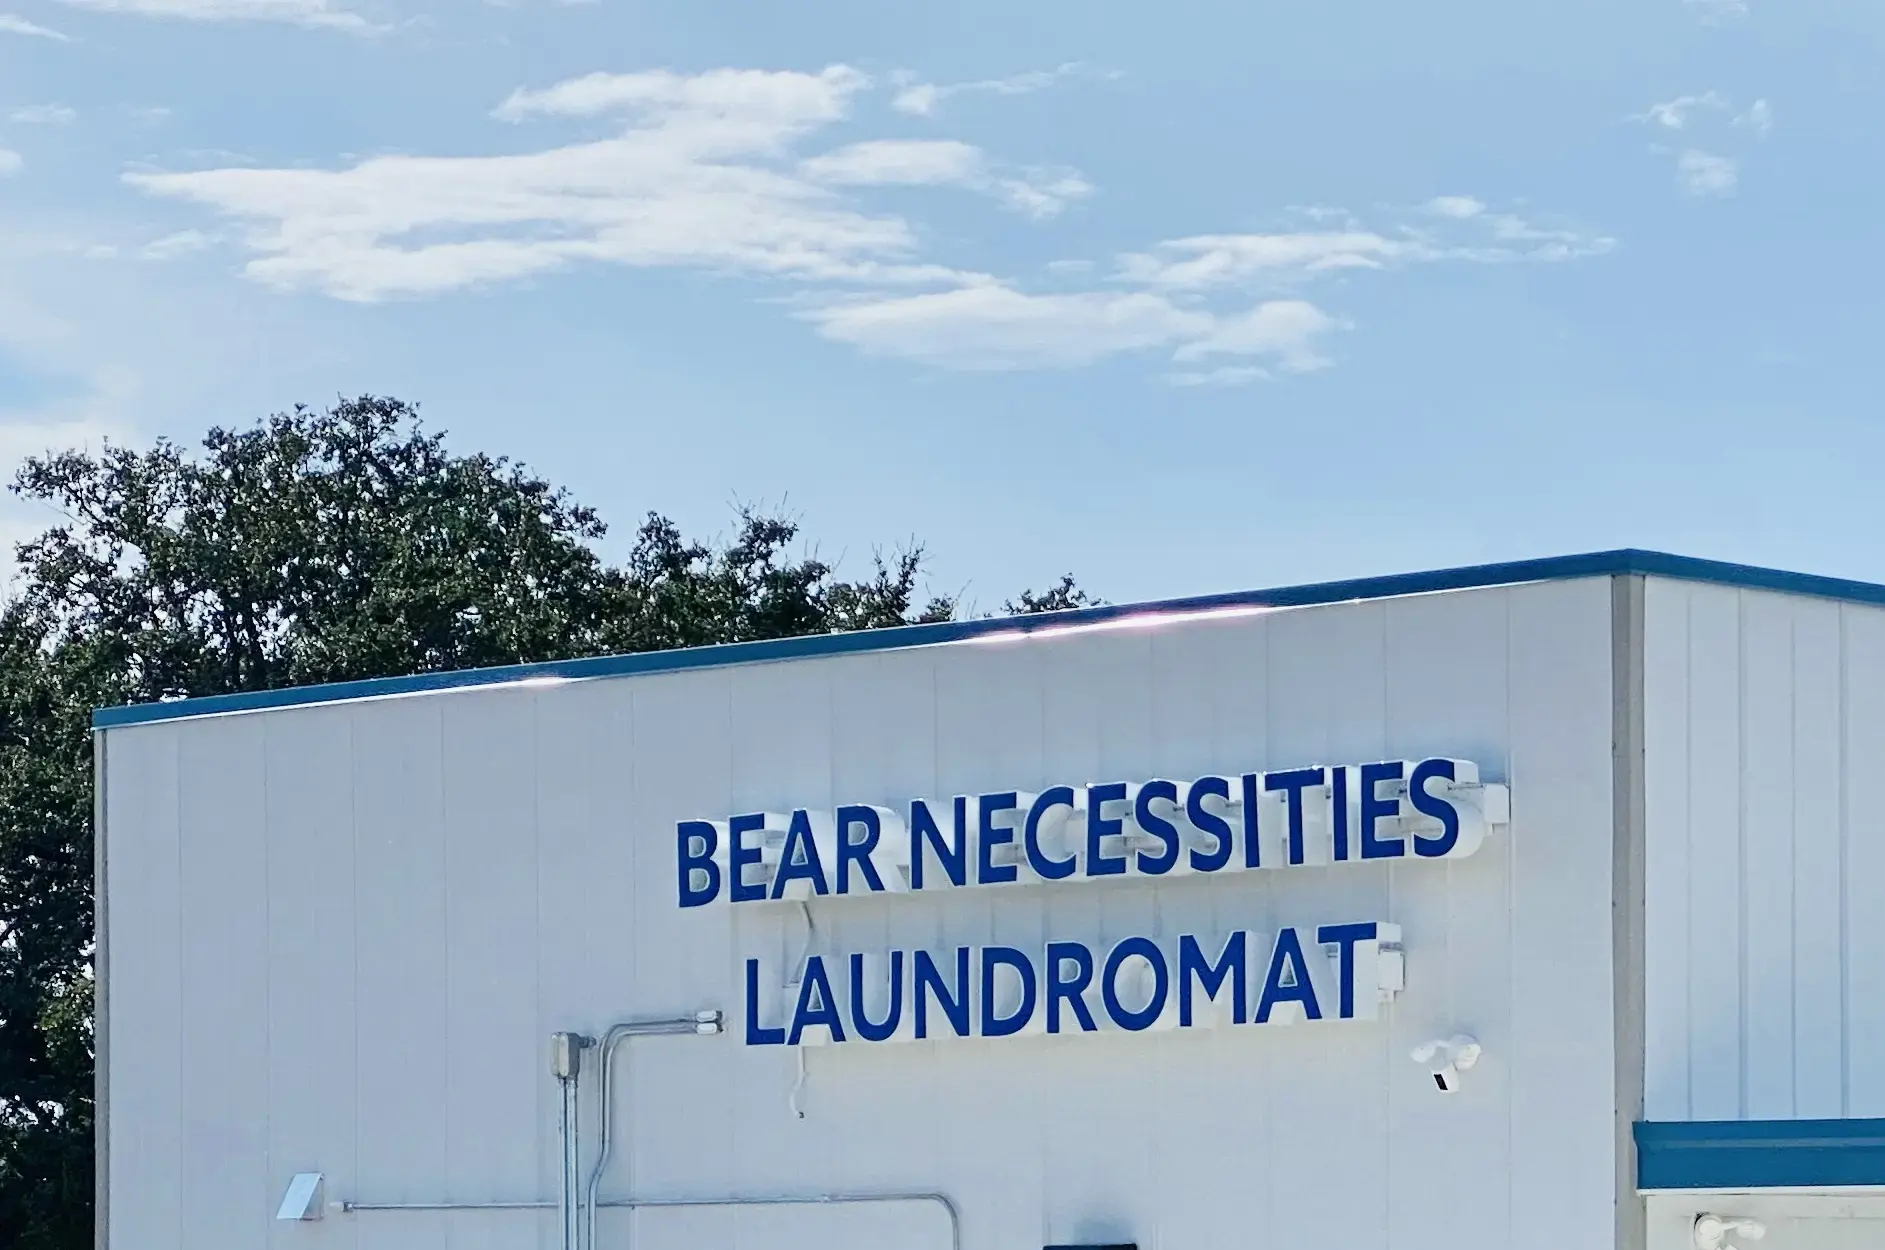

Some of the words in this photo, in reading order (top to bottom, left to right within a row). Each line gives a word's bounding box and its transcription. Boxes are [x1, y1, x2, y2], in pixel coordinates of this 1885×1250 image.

[675, 804, 888, 910] BEAR
[909, 757, 1460, 891] NECESSITIES
[744, 920, 1379, 1047] LAUNDROMAT
